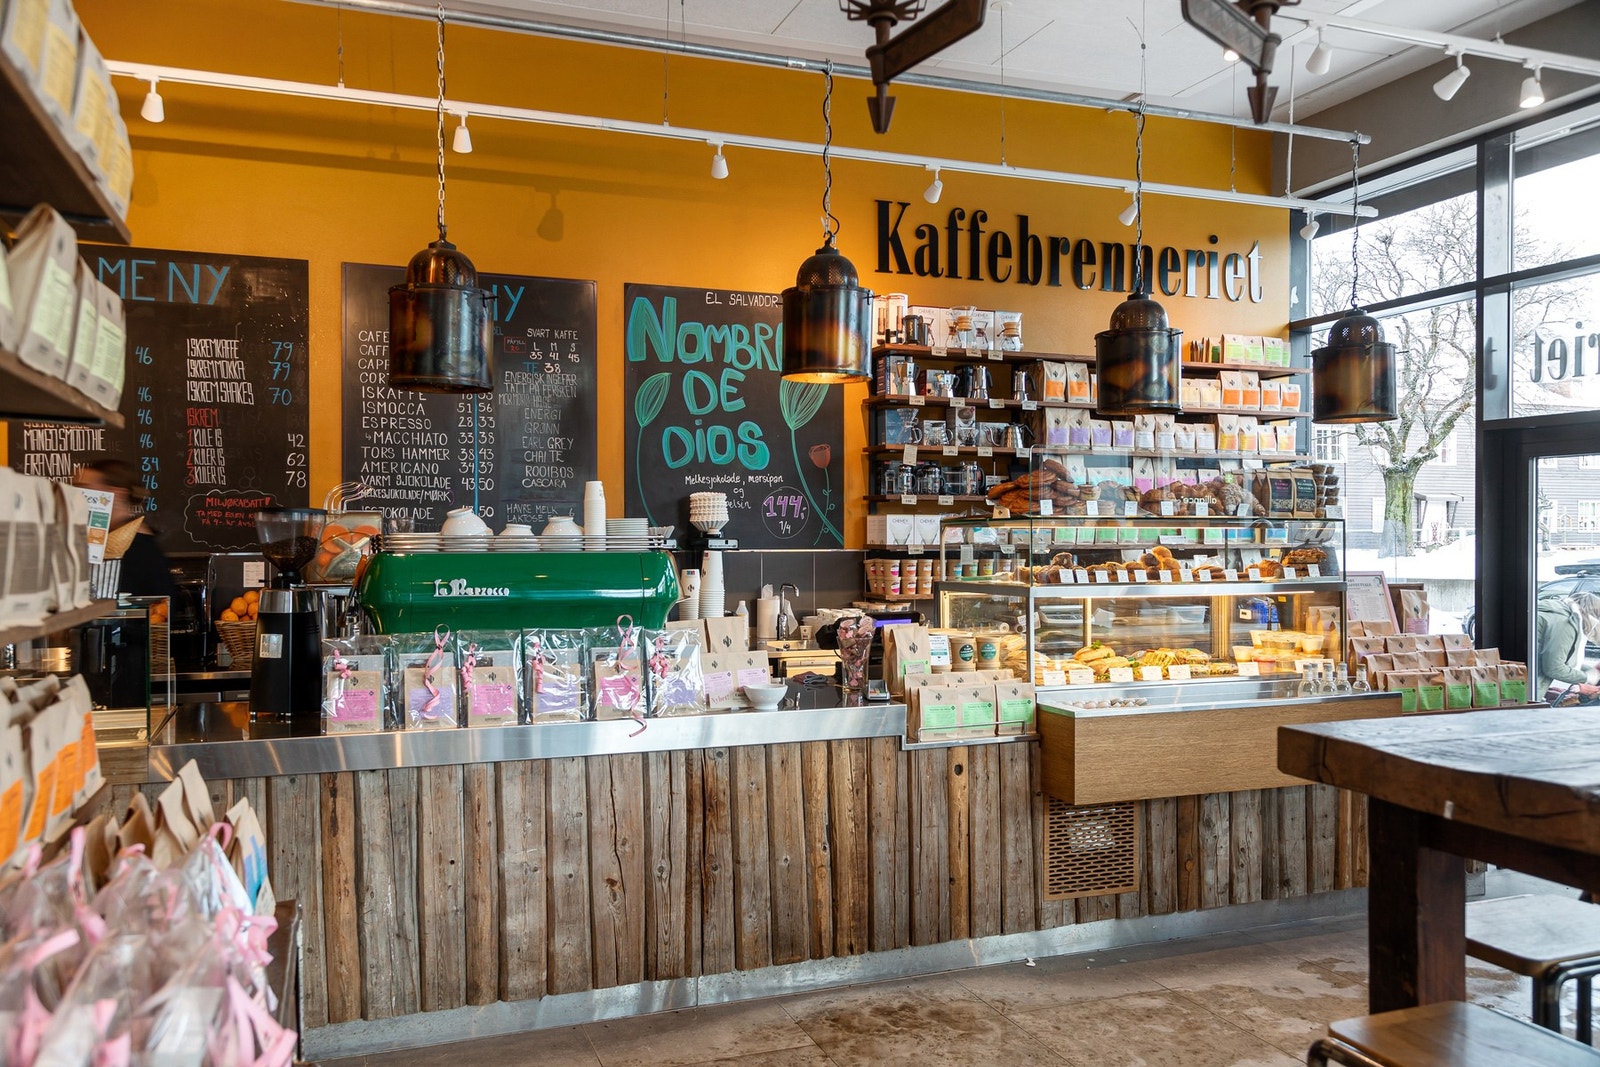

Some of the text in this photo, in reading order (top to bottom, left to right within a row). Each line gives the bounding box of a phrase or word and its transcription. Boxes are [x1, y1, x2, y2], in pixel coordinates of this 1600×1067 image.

[875, 198, 1263, 304] Kaffebrenneriet
[98, 257, 231, 305] MENY
[706, 292, 779, 308] EL SALVADOR
[527, 328, 579, 340] SVART KAFFE
[626, 296, 784, 373] NOMBR
[135, 346, 154, 365] 46
[272, 341, 293, 361] 79
[359, 345, 390, 357] CAFF
[529, 352, 580, 363] 35 41 45
[268, 360, 291, 382] 79
[544, 363, 561, 373] 38
[137, 386, 153, 403] 46
[268, 387, 292, 406] 70
[682, 368, 746, 416] DE
[361, 401, 493, 416] ISMOCCA 51 56
[524, 408, 562, 421] ENERGI
[137, 408, 154, 426] 46
[361, 416, 496, 430] ESPRESSO 28 33
[139, 434, 155, 449] 46
[287, 433, 306, 448] 42
[373, 431, 495, 446] MACCHIATO 33 38
[547, 437, 575, 450] GREY
[286, 453, 306, 467] 62
[360, 446, 495, 461] TORS HAMMER 38 43
[141, 457, 160, 472] 34
[360, 461, 439, 475] AMERICANO
[478, 461, 494, 474] 39
[525, 465, 575, 479] ROOIBOS
[142, 475, 159, 490] 46
[286, 471, 306, 488] 78
[360, 474, 495, 490] VARM SJOKOLADE 43 50
[522, 479, 567, 489] CASCARA
[478, 506, 495, 518] 50
